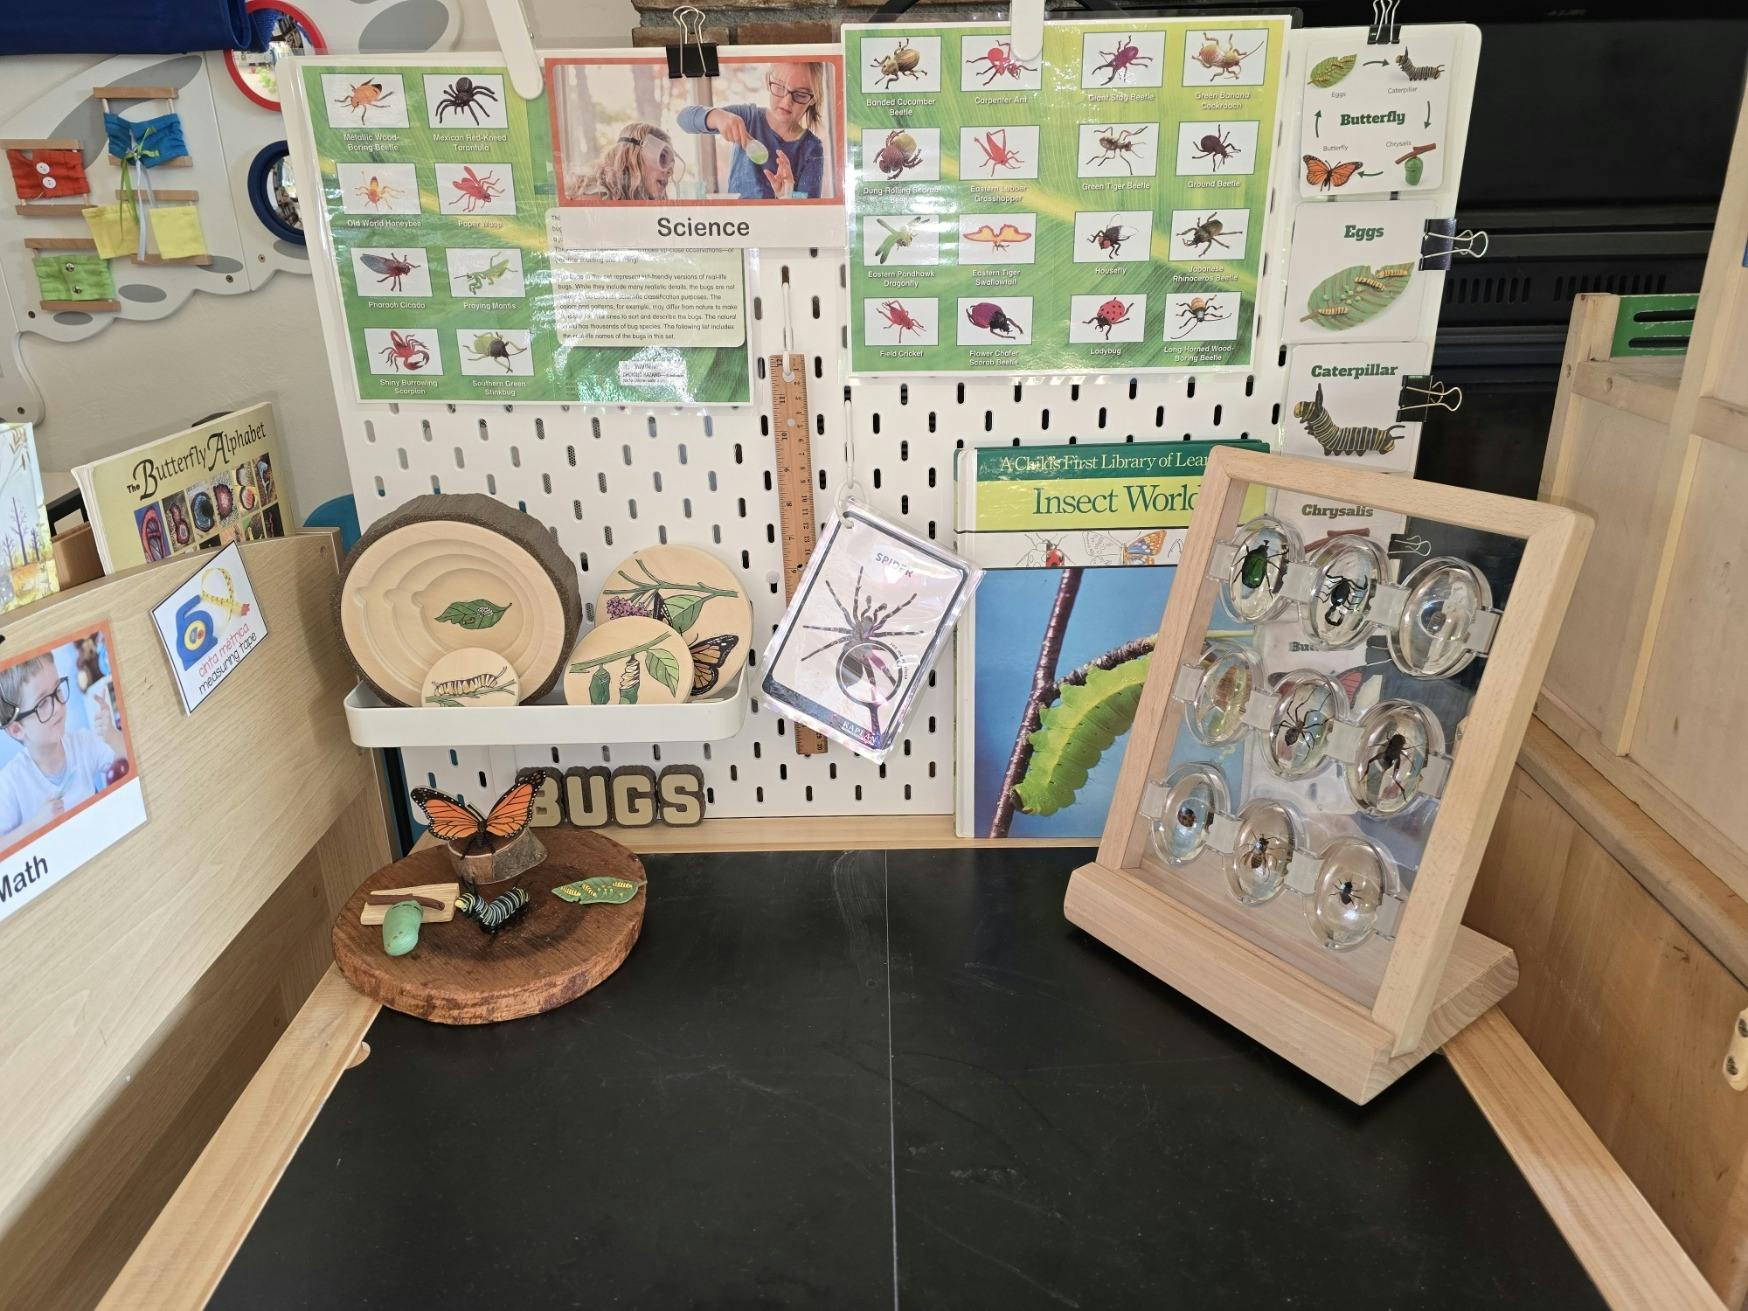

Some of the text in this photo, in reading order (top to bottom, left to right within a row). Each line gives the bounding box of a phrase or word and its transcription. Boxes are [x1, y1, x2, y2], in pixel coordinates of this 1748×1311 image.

[866, 98, 936, 106] Banded Cucumber
[974, 96, 1012, 104] Carpenter
[1340, 110, 1406, 126] Butterfly
[348, 144, 374, 152] Boring
[1386, 140, 1412, 148] Chrysalis
[1082, 182, 1104, 190] Green
[1128, 182, 1150, 190] Beetle
[1188, 180, 1216, 188] Ground
[975, 195, 1023, 203] Grasshopper
[386, 220, 422, 228] Honeybee
[657, 216, 750, 237] Science
[1344, 225, 1384, 242] Eggs
[1095, 267, 1126, 276] Housefly
[1188, 265, 1224, 273] Japanese
[1002, 269, 1021, 278] Tiger
[884, 280, 919, 288] Dragonfly
[975, 278, 1017, 286] Swallowtail
[463, 302, 491, 310] Praying
[1090, 348, 1122, 356] Ladybug
[1310, 363, 1398, 379] Caterpillar
[380, 379, 438, 388] Shiny Burrowing
[395, 388, 426, 396] Scorpion
[485, 388, 516, 397] Stinkbug
[126, 422, 267, 501] The Butterfly Alphabet
[1000, 456, 1013, 472] A
[1064, 454, 1098, 470] First
[1102, 454, 1157, 472] Library
[1158, 452, 1174, 468] of
[1032, 486, 1119, 515] Insect
[1301, 504, 1374, 519] Chrysalis
[199, 632, 257, 695] measuring tape
[518, 766, 704, 827] BUGS
